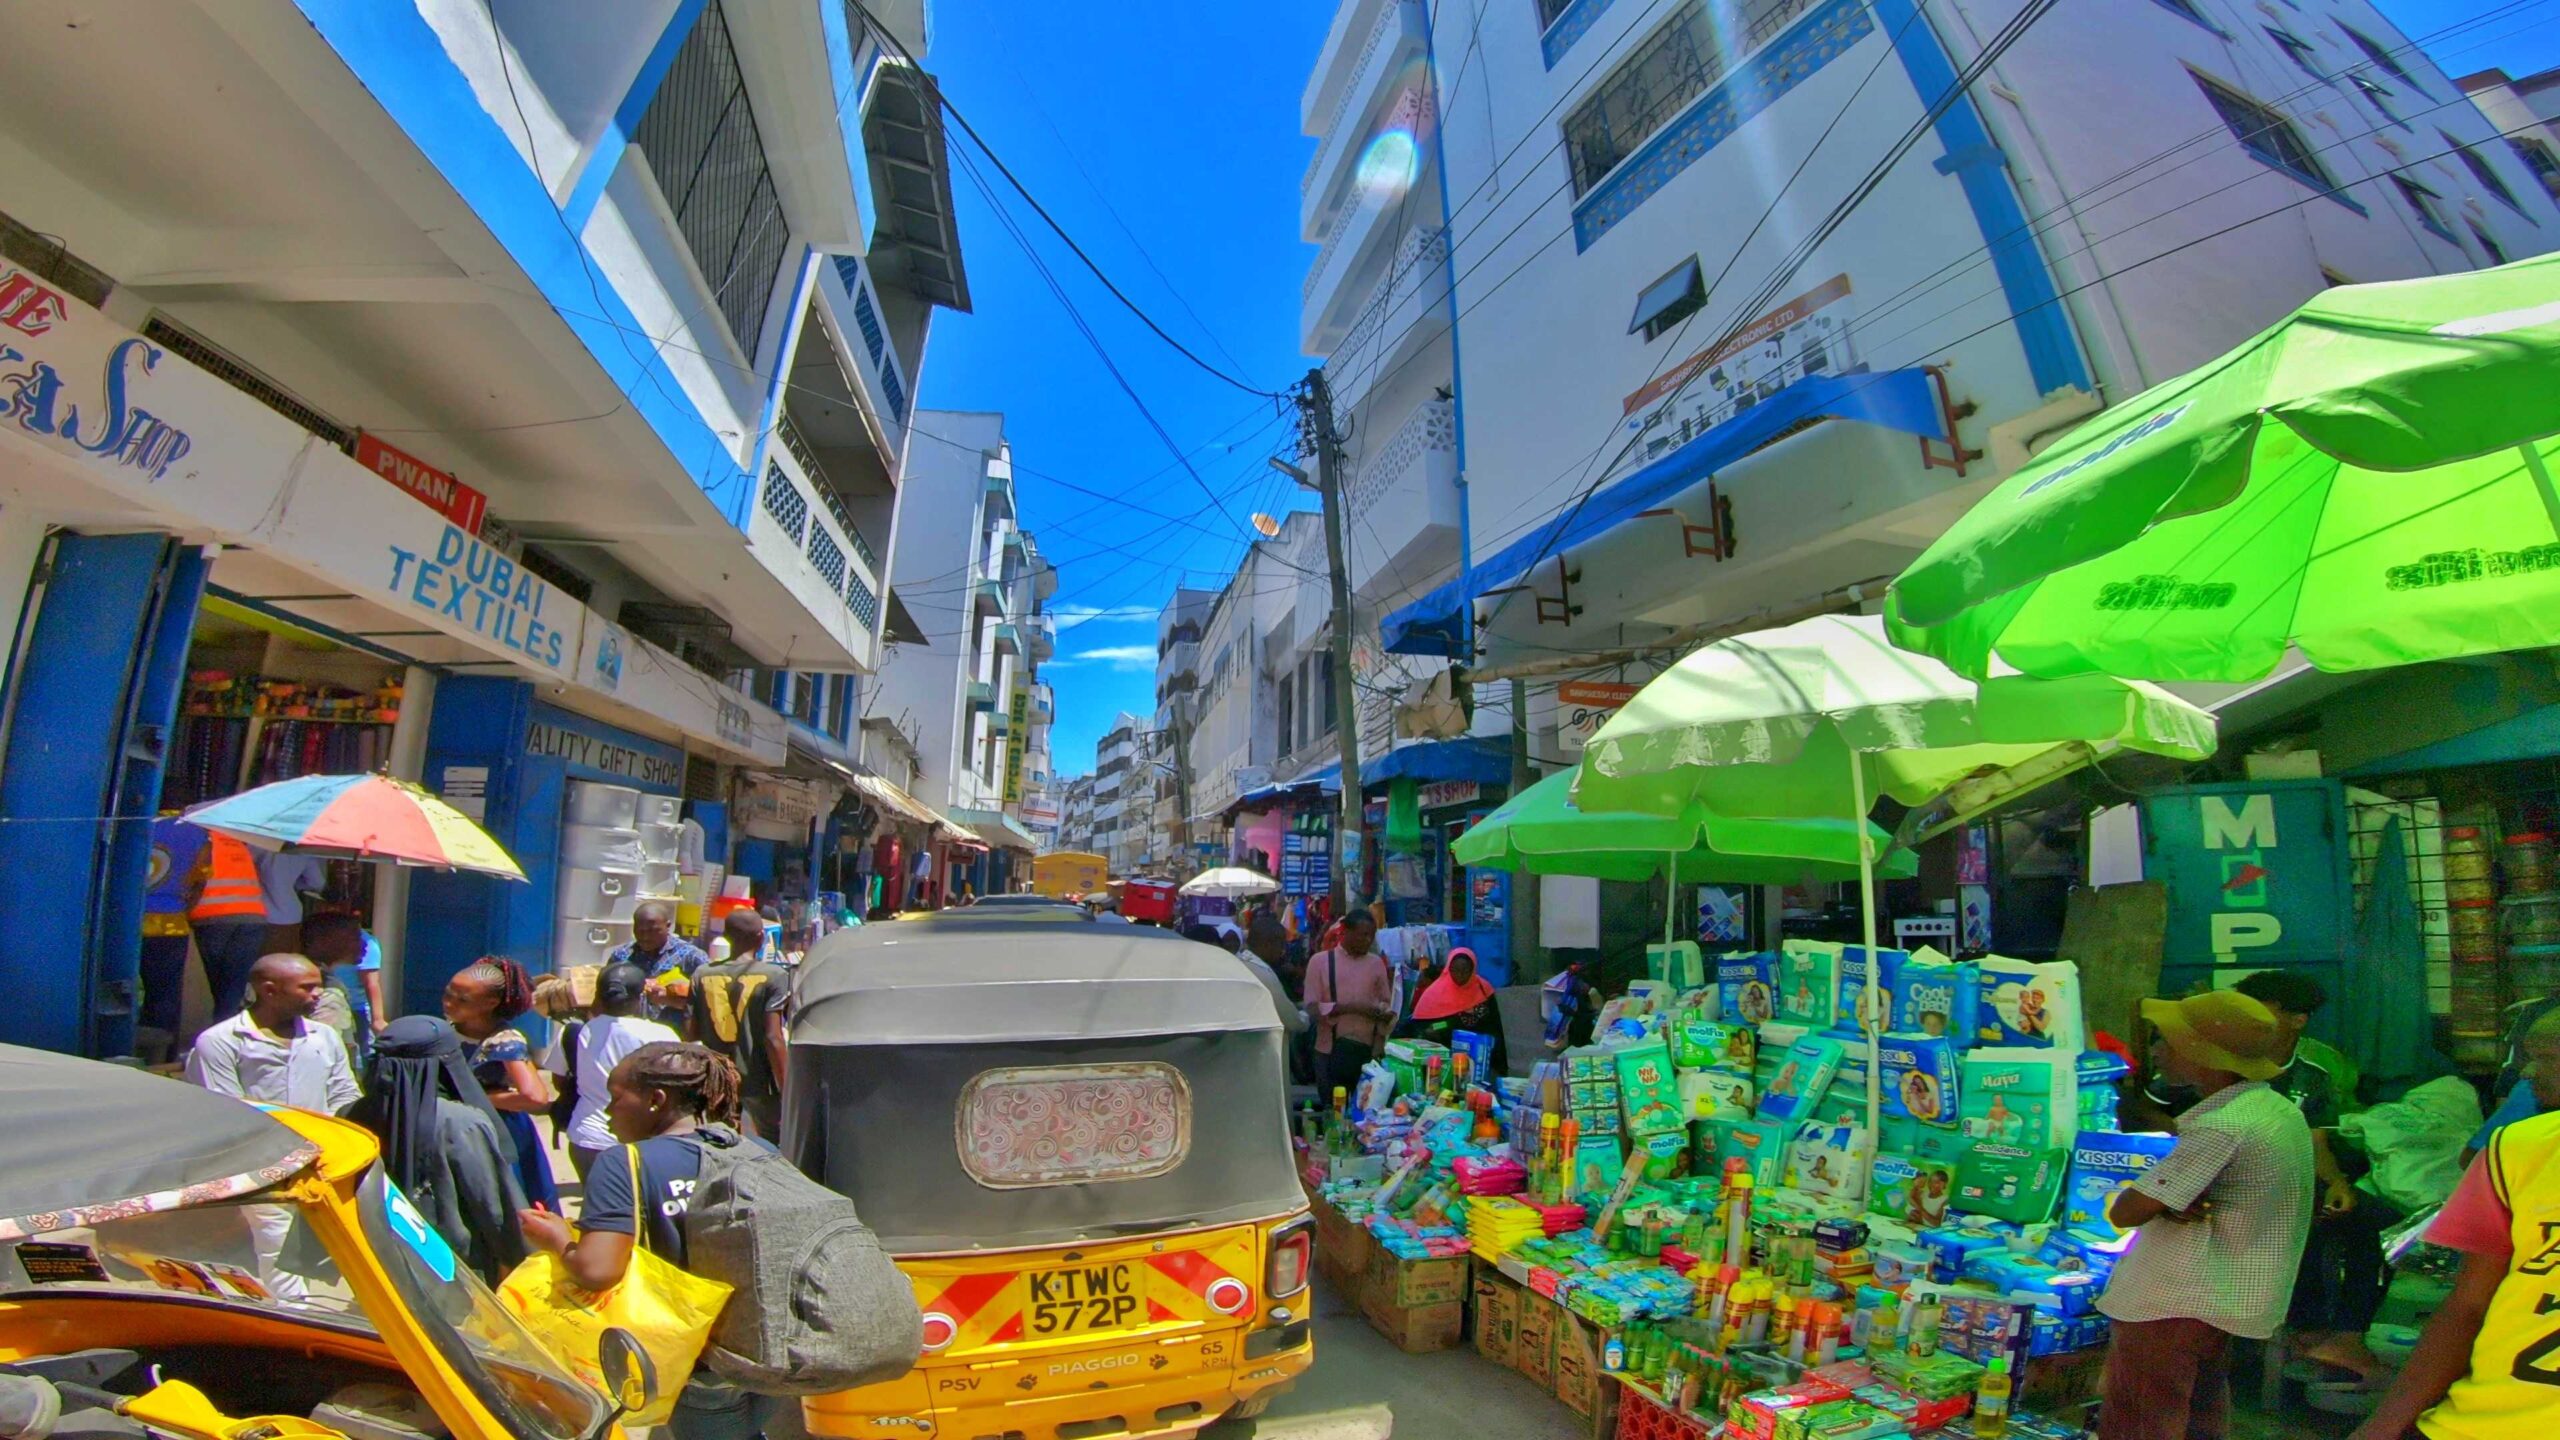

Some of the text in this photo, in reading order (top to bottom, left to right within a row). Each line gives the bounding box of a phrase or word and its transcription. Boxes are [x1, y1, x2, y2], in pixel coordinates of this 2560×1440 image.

[1774, 308, 1795, 329] LTD
[376, 450, 458, 508] PWANI
[436, 523, 546, 618] DUBAI
[388, 544, 563, 668] TEXTILES
[526, 721, 680, 787] ALITY GIFT SHOP
[1444, 780, 1477, 802] SHOP
[1687, 1026, 1726, 1039] molfix
[1649, 1134, 1686, 1149] molfix
[1874, 1161, 1918, 1178] molfix
[1030, 1264, 1130, 1303] KTWC
[1033, 1295, 1137, 1334] 572P
[1200, 1341, 1224, 1356] 65
[1048, 1353, 1140, 1377] PIAGGIO
[1201, 1356, 1228, 1370] KPH
[939, 1376, 981, 1392] PSV
